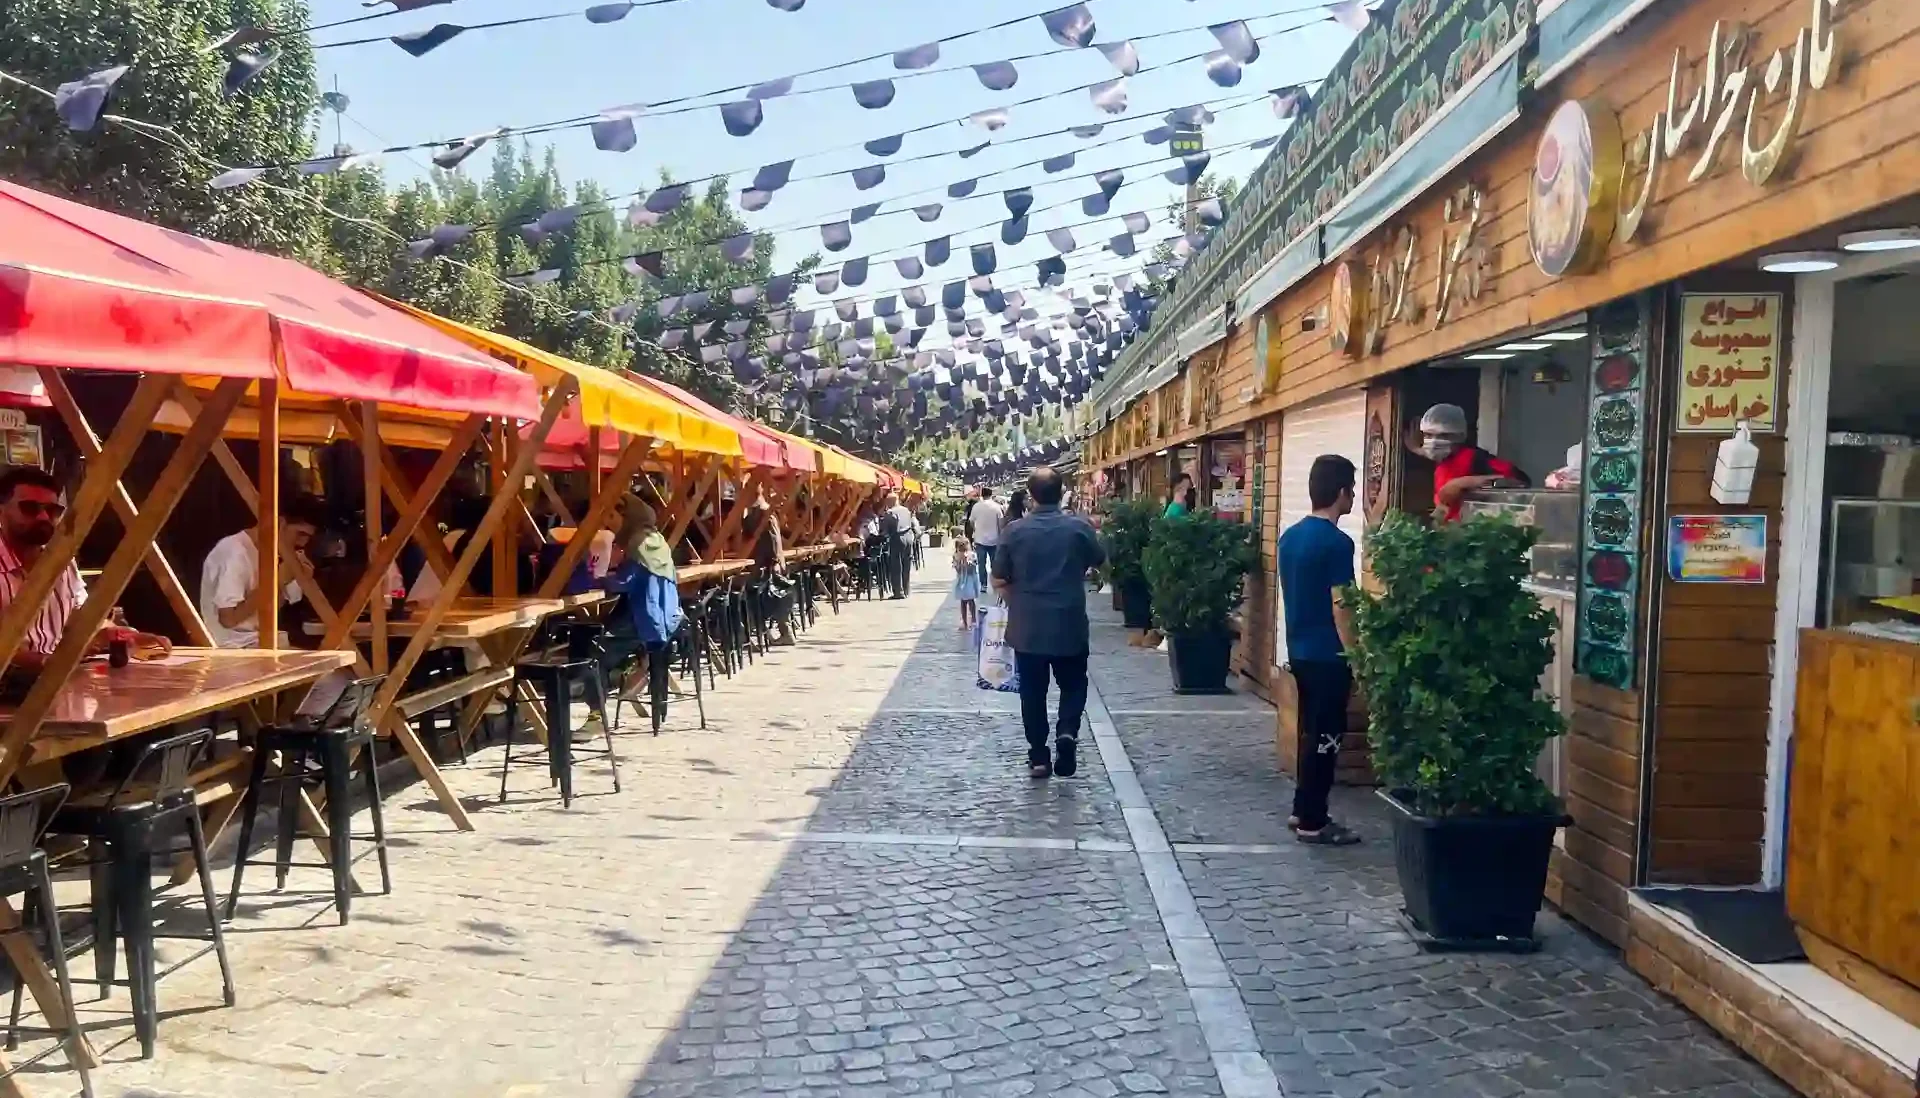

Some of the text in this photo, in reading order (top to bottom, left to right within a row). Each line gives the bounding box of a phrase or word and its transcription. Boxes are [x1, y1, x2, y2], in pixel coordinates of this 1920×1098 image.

[1617, 19, 1749, 243] خراسان
[1701, 298, 1766, 325] انواع
[1690, 330, 1771, 355] سمبوسه
[1686, 356, 1771, 387] تنوری
[1685, 393, 1769, 425] خراسان
